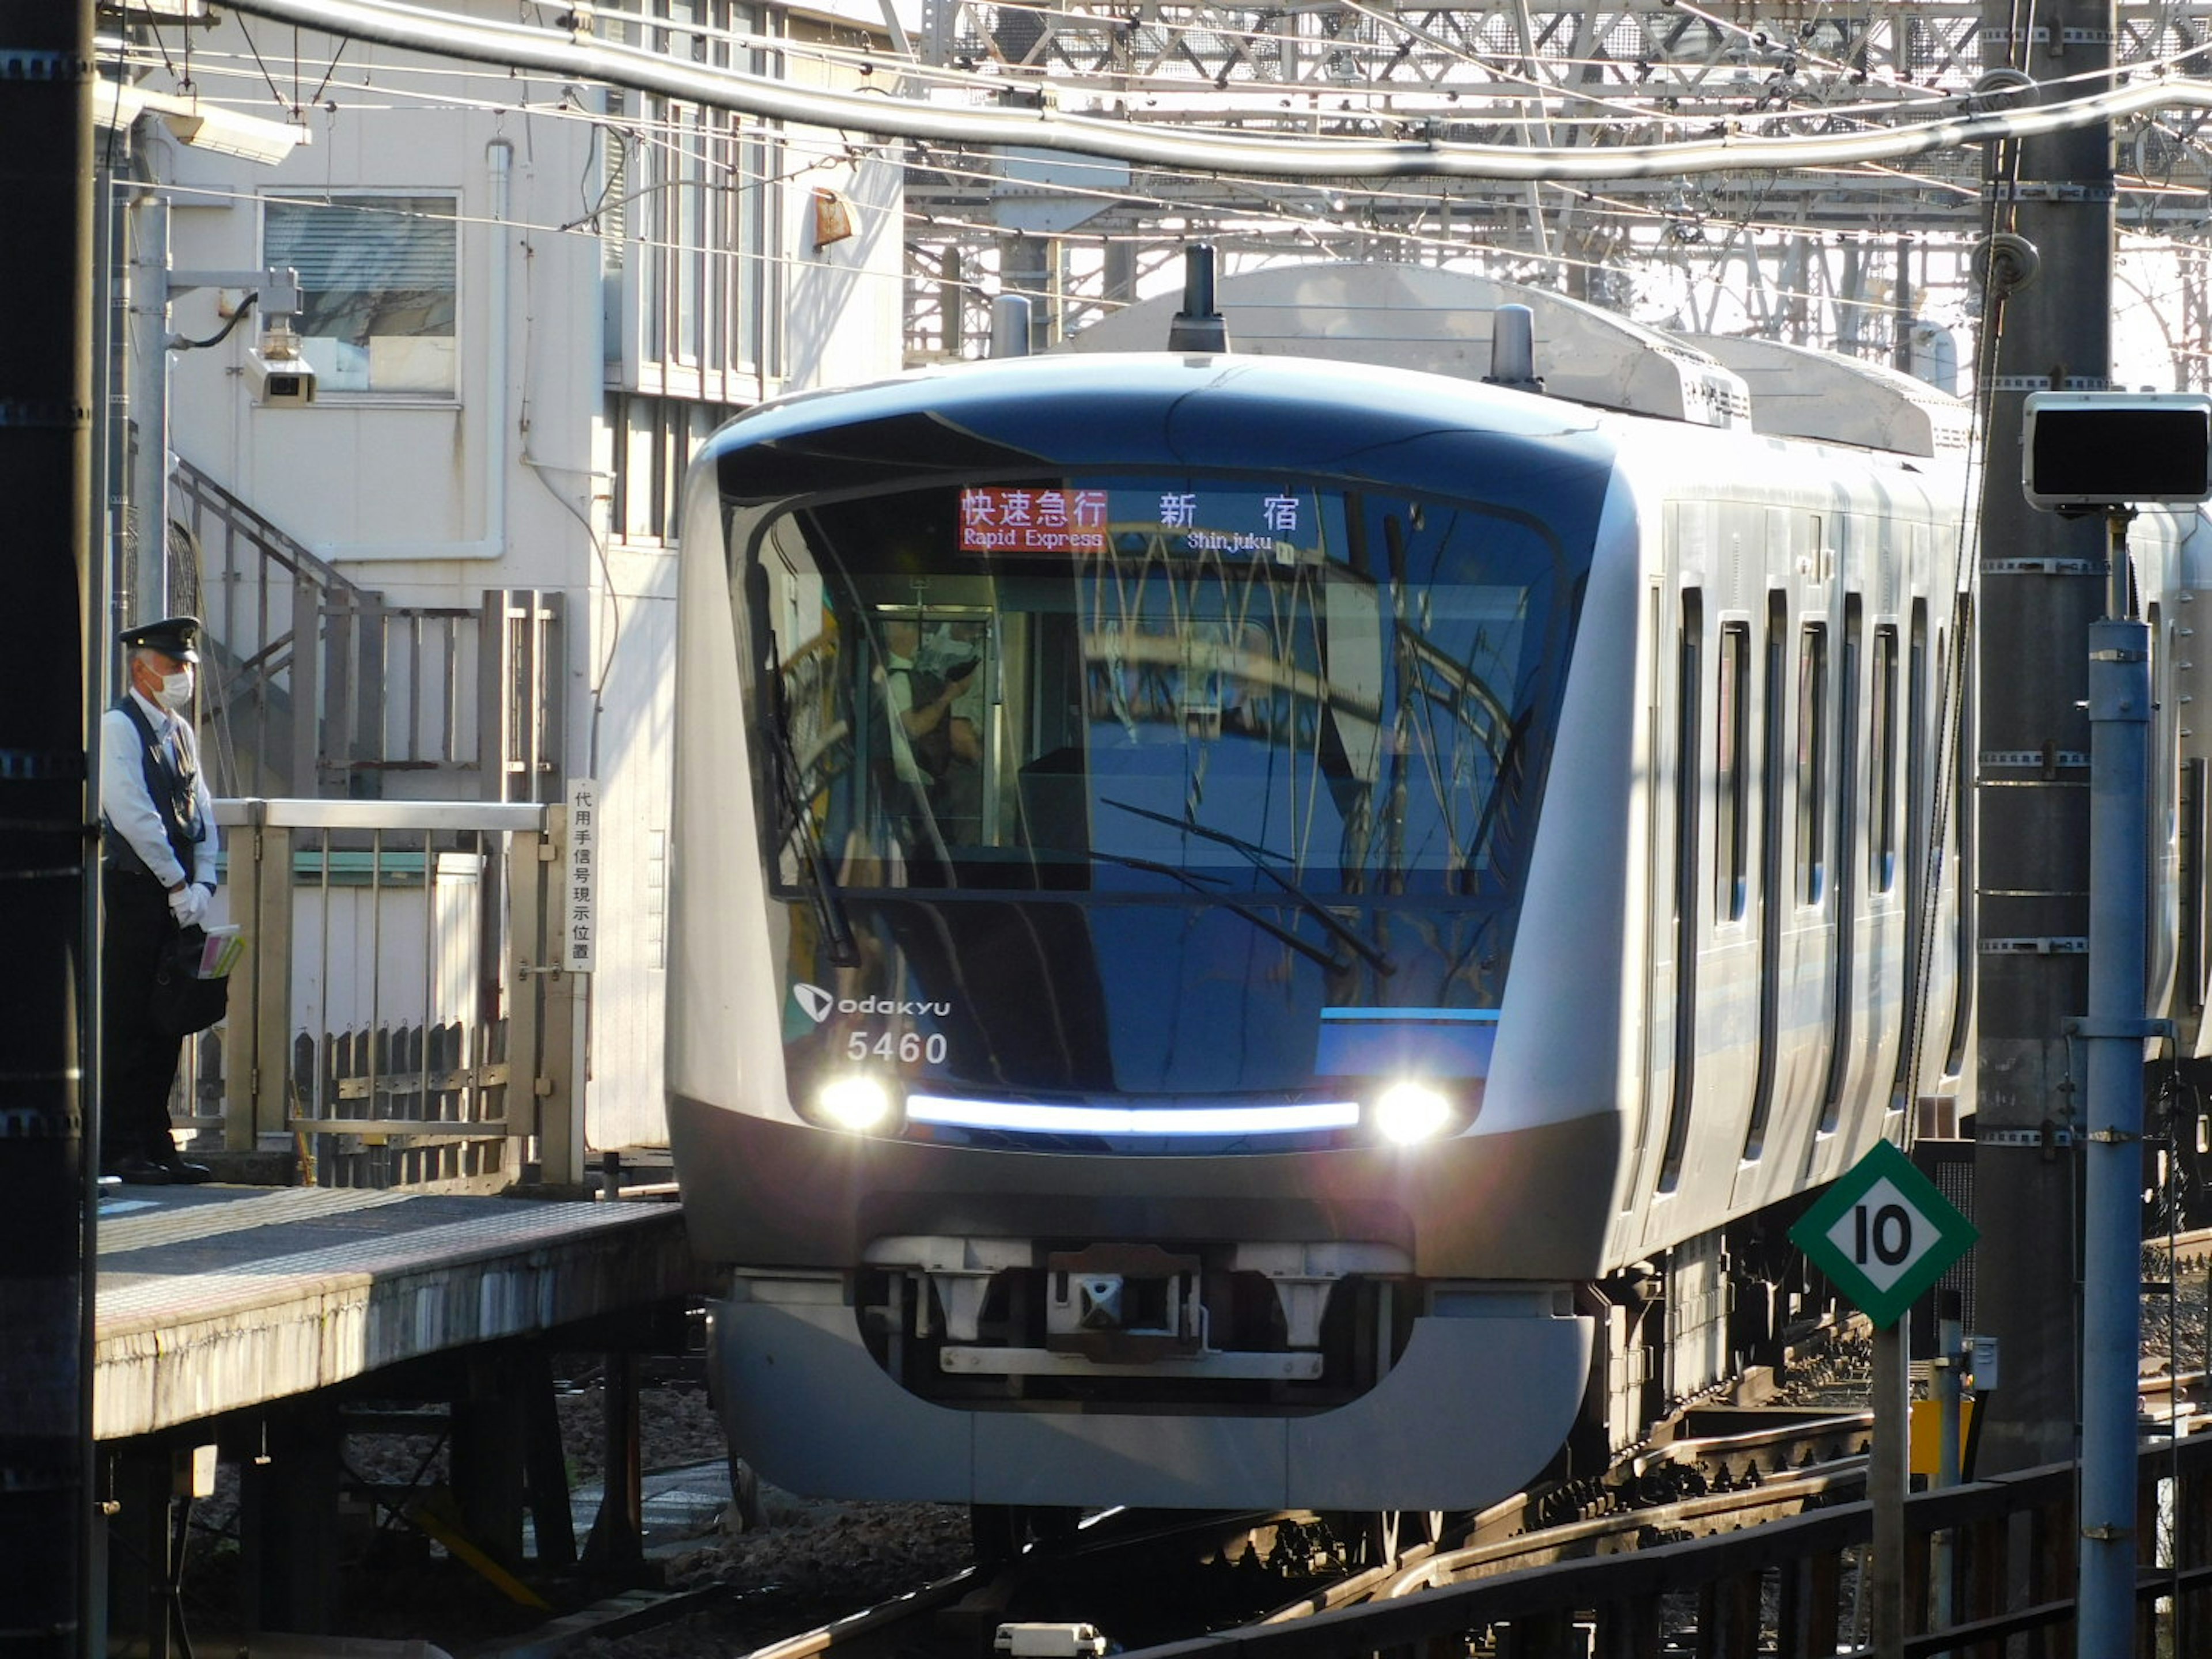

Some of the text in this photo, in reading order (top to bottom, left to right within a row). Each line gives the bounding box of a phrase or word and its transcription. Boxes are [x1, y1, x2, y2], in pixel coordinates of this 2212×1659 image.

[961, 489, 1107, 528] 快速急行
[964, 529, 1104, 548] Rapid Express
[1187, 532, 1272, 552] Shinjuku
[572, 791, 592, 960] 代用手信号現示位置
[838, 994, 951, 1017] odakyu
[847, 1031, 948, 1064] 5460
[1855, 1204, 1912, 1266] 10
